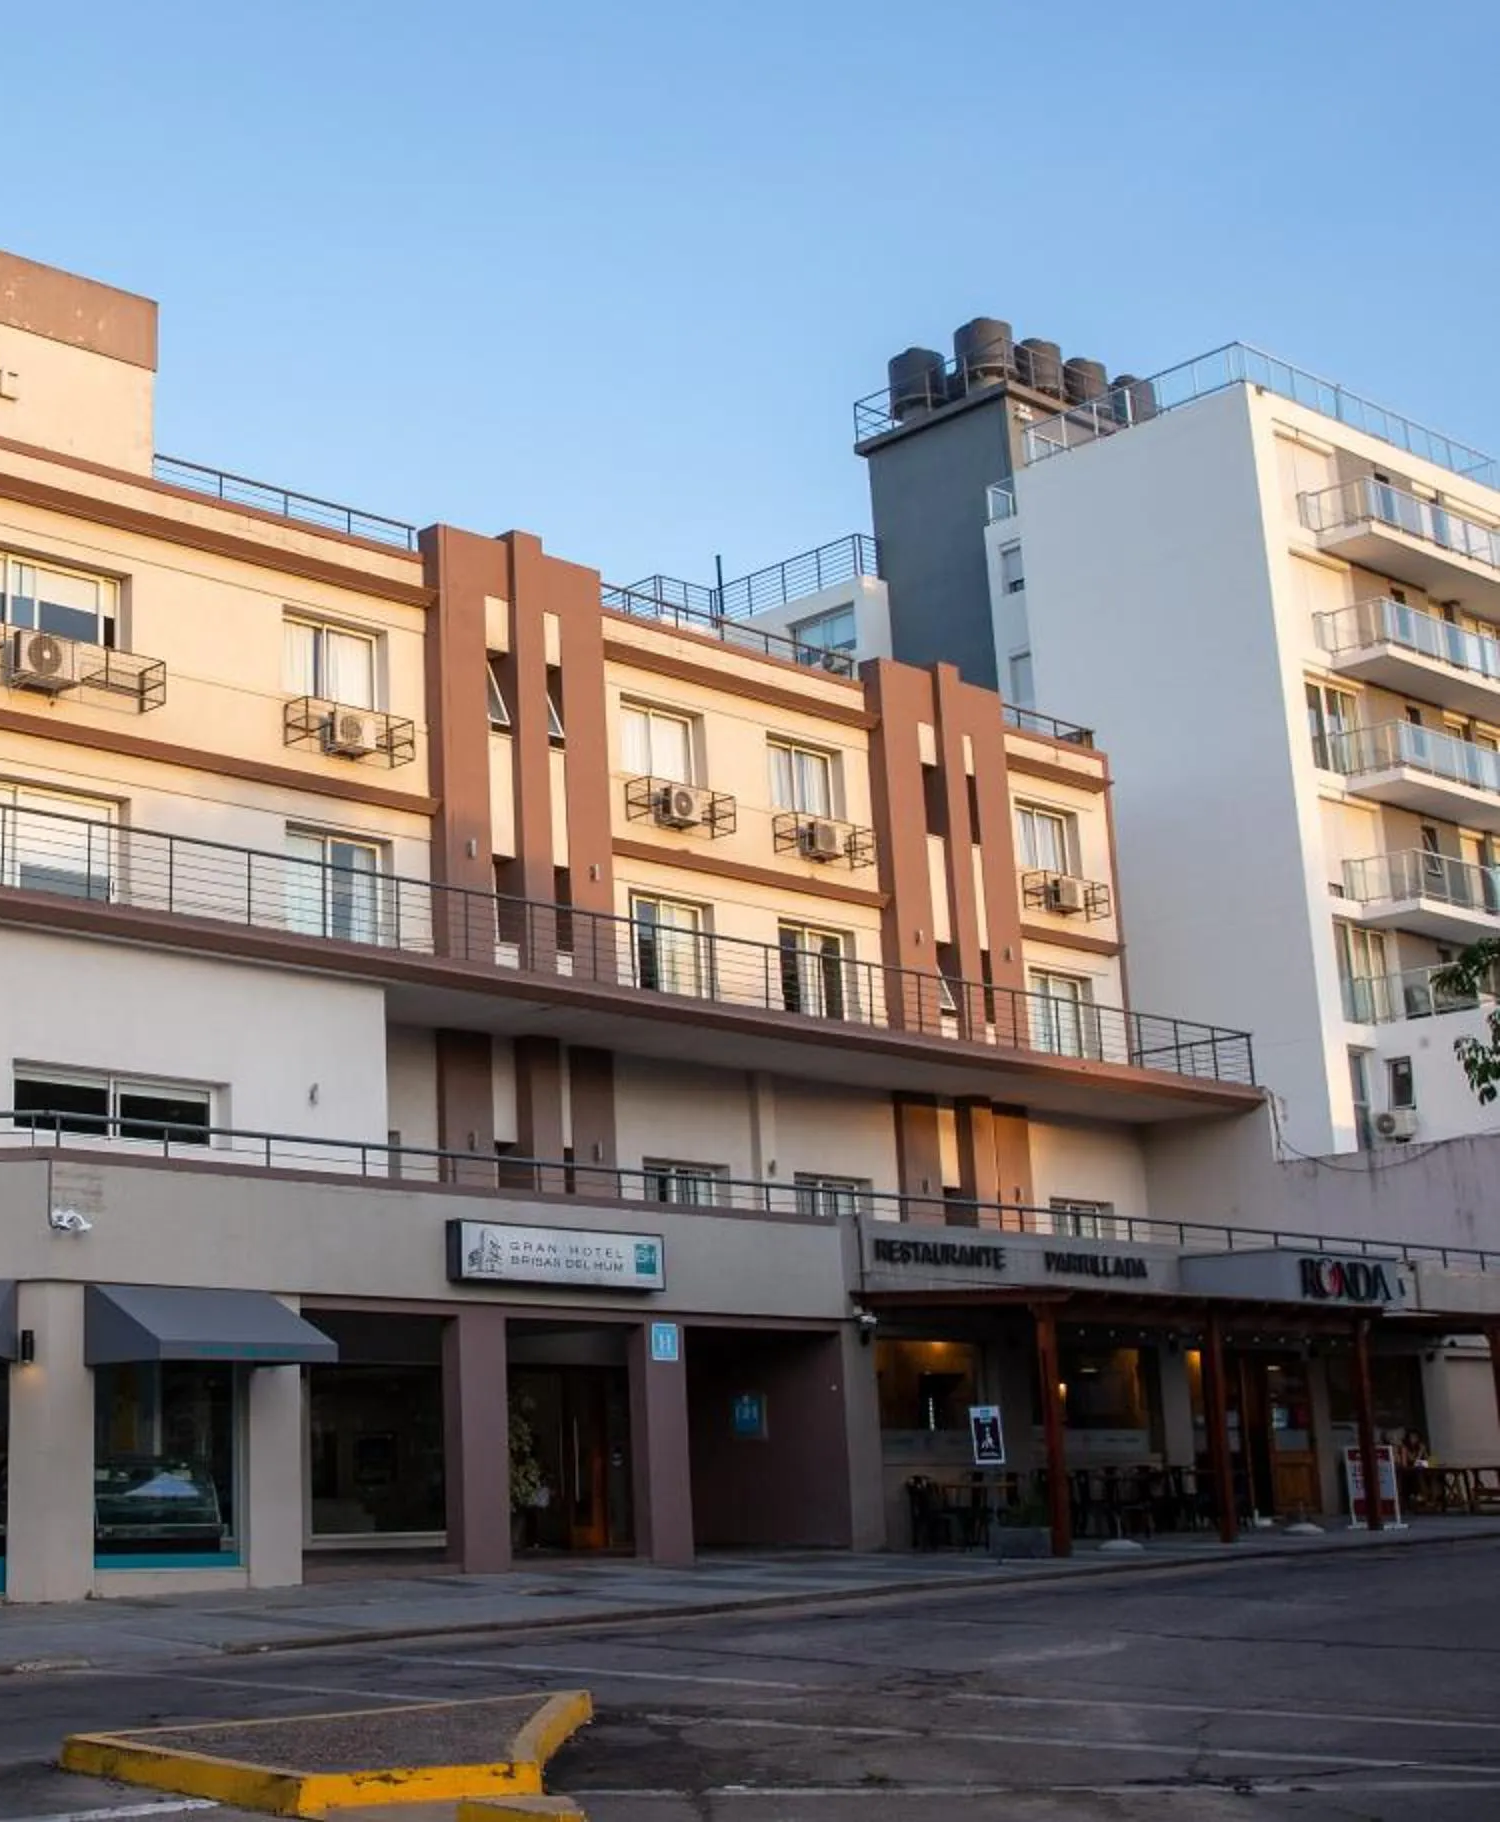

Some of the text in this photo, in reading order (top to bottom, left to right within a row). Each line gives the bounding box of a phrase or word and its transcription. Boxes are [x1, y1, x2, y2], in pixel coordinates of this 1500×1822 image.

[509, 1241, 557, 1254] GRAN
[568, 1247, 624, 1259] HOTEL
[872, 1238, 1148, 1279] RESTAURANTE PARRILLADA
[510, 1255, 624, 1273] BRISAS DEL HUM
